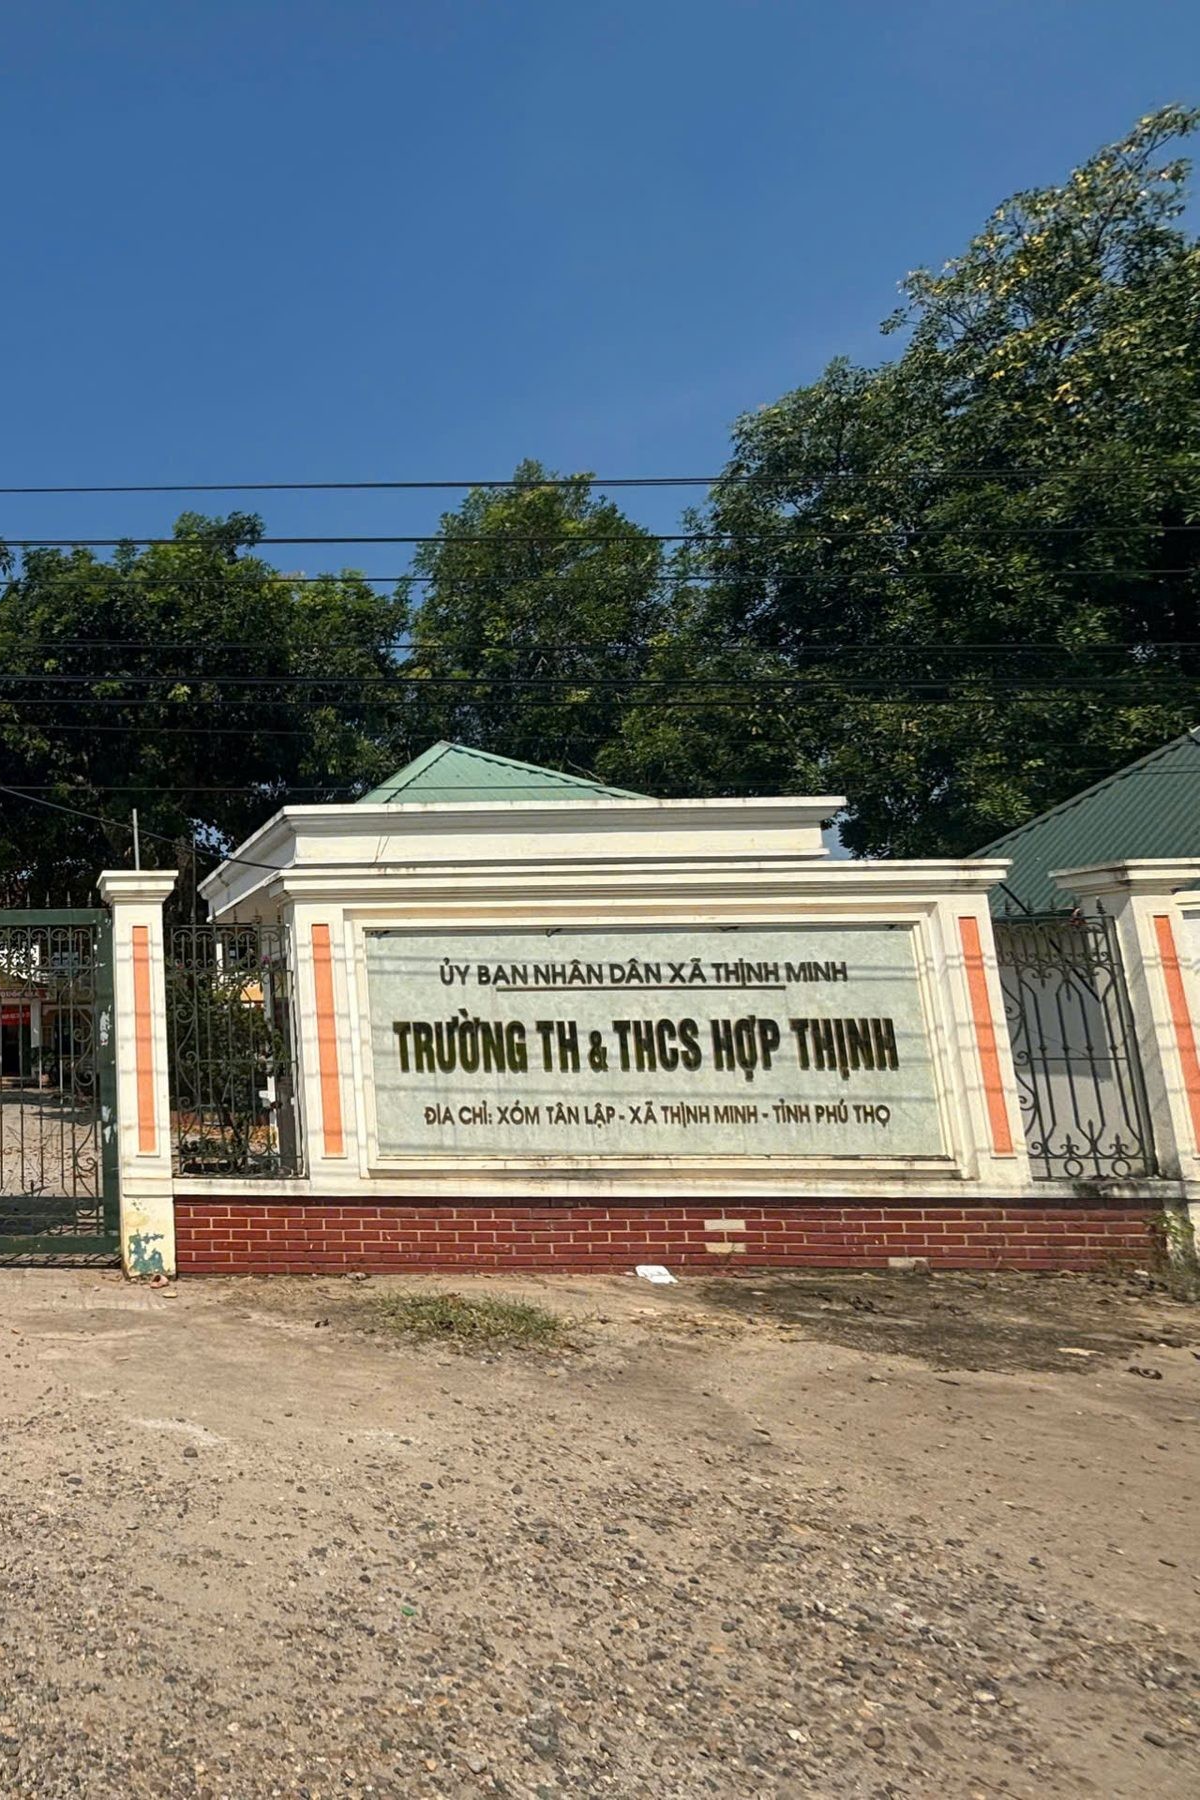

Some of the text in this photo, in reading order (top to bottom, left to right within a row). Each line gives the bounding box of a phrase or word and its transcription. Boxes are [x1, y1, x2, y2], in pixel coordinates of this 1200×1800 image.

[439, 957, 849, 986] ỦY BAN NHÂN DÂN XÃ THỊNH MINH
[392, 1008, 899, 1082] TRƯỜNG TH & THCS HỢP THỊNH
[459, 1100, 492, 1125] CHỈ:
[497, 1100, 540, 1126] XÓM
[546, 1102, 579, 1126] TÂN
[583, 1102, 616, 1129] LẬP
[629, 1101, 657, 1124] XÃ
[660, 1101, 710, 1128] THỊNH
[713, 1105, 759, 1124] MINH
[772, 1098, 811, 1124] TỈNH
[815, 1098, 849, 1124] PHÚ
[853, 1104, 891, 1128] THỌ
